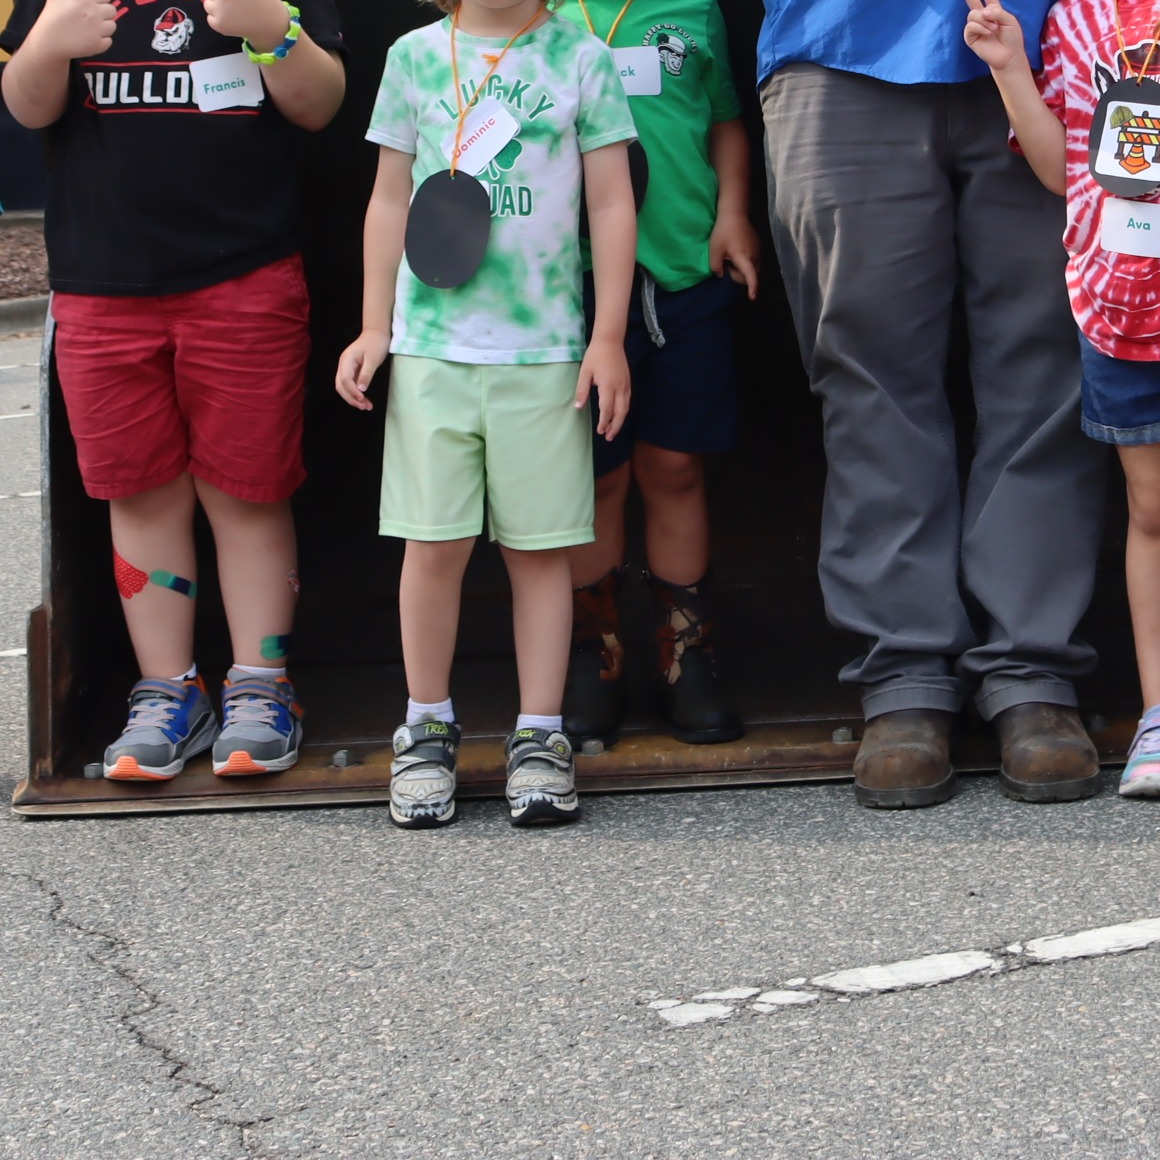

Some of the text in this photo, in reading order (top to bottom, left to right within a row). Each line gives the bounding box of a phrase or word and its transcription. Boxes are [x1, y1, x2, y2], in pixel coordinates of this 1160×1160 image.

[620, 65, 636, 77] ck
[203, 77, 246, 95] Francis
[438, 73, 555, 121] LUCKY
[1127, 217, 1151, 231] Ava
